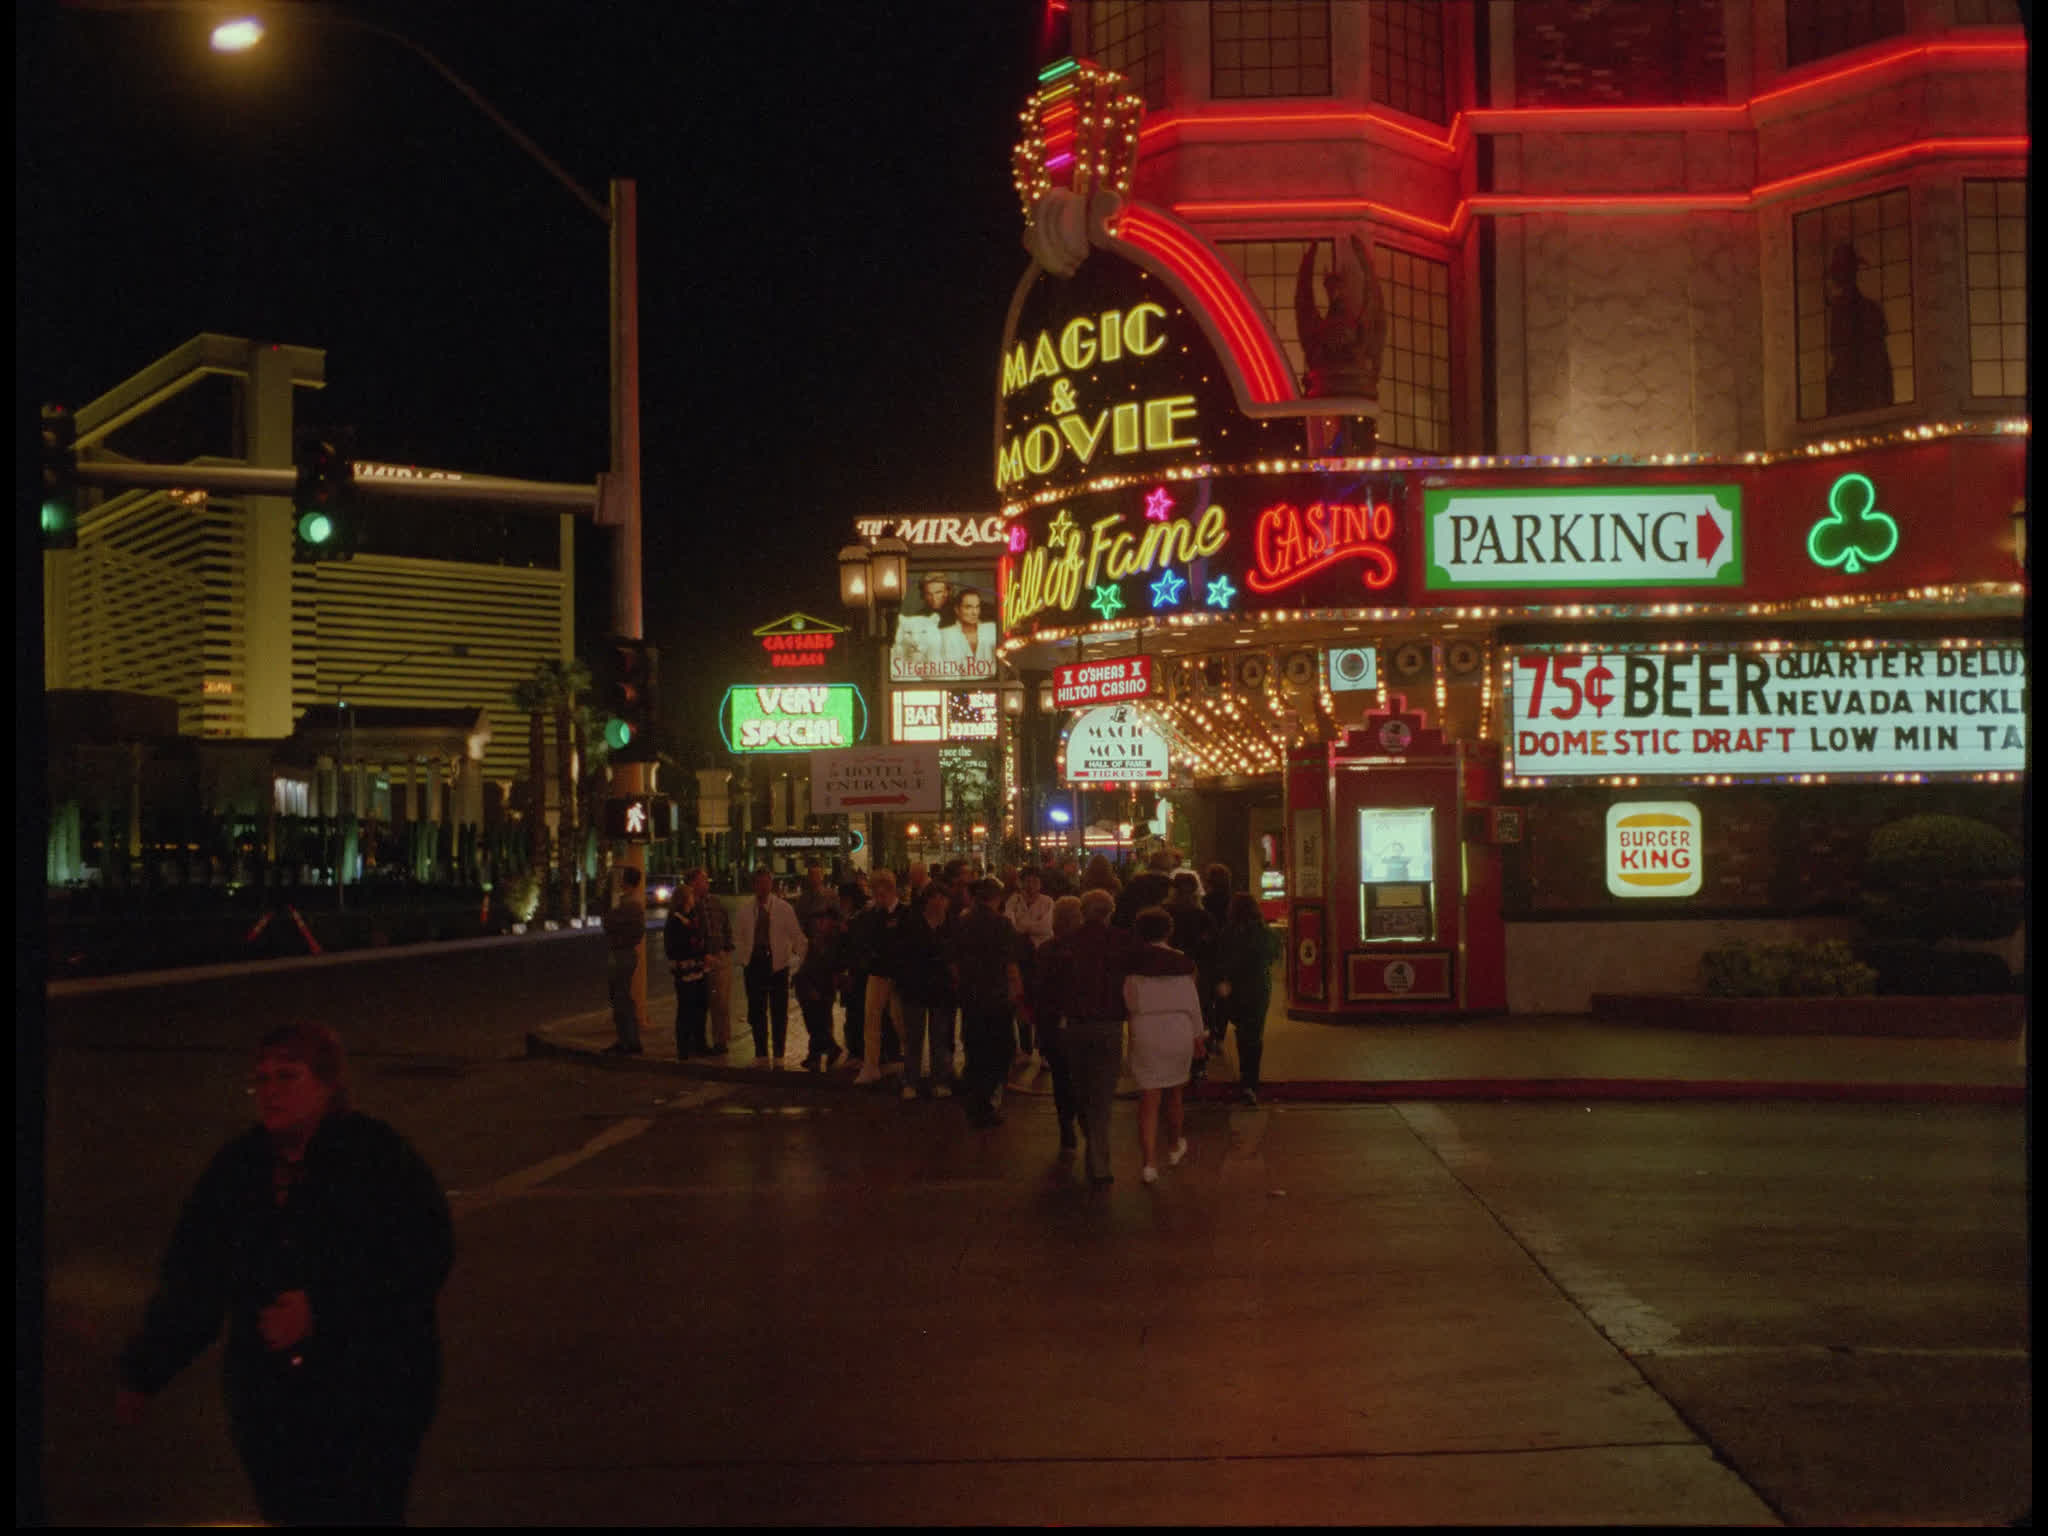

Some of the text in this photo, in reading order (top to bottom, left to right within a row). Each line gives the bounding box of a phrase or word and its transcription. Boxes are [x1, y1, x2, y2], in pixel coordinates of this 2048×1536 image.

[1002, 303, 1166, 397] MAGIC
[1050, 379, 1076, 414] &
[996, 396, 1198, 490] MOVIE
[896, 517, 1010, 546] MIRAG
[1255, 502, 1394, 580] CASINO
[1450, 511, 1689, 565] PARKING
[1044, 527, 1085, 611] of
[1086, 505, 1228, 590] Fame
[1078, 664, 1126, 683] O'SHEAS
[1775, 648, 1924, 679] QUARTER
[757, 686, 829, 715] VERY
[1057, 678, 1147, 702] HILTON CASINO
[1518, 652, 1771, 720] 75¢ BEER
[905, 706, 939, 725] BAR
[1777, 690, 1913, 716] NEVADA
[741, 718, 845, 747] SPECIAL
[1518, 729, 1681, 757] DOMESTIC
[1692, 727, 1796, 754] DRAFT
[1810, 726, 1878, 752] LOW
[1894, 726, 1958, 751] MIN
[1619, 830, 1691, 848] BURGER
[1620, 848, 1691, 870] KING
